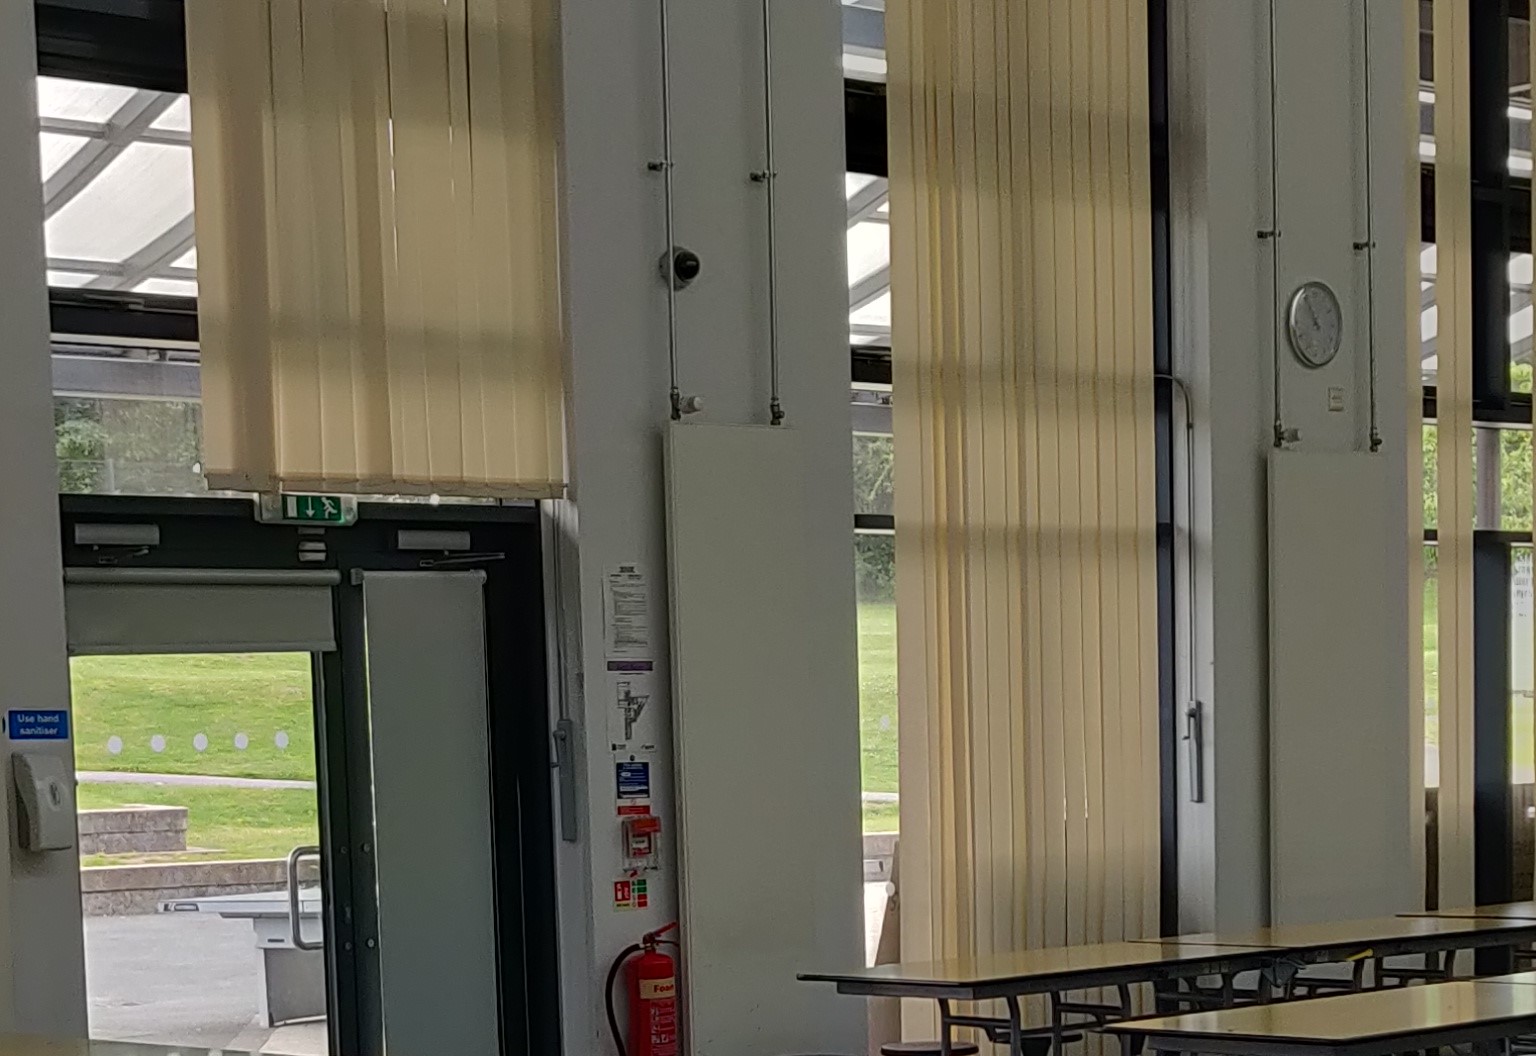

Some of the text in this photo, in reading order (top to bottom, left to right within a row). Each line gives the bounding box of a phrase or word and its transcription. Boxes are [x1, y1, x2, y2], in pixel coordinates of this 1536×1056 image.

[17, 714, 59, 723] Use hand
[20, 726, 58, 735] sanitiser
